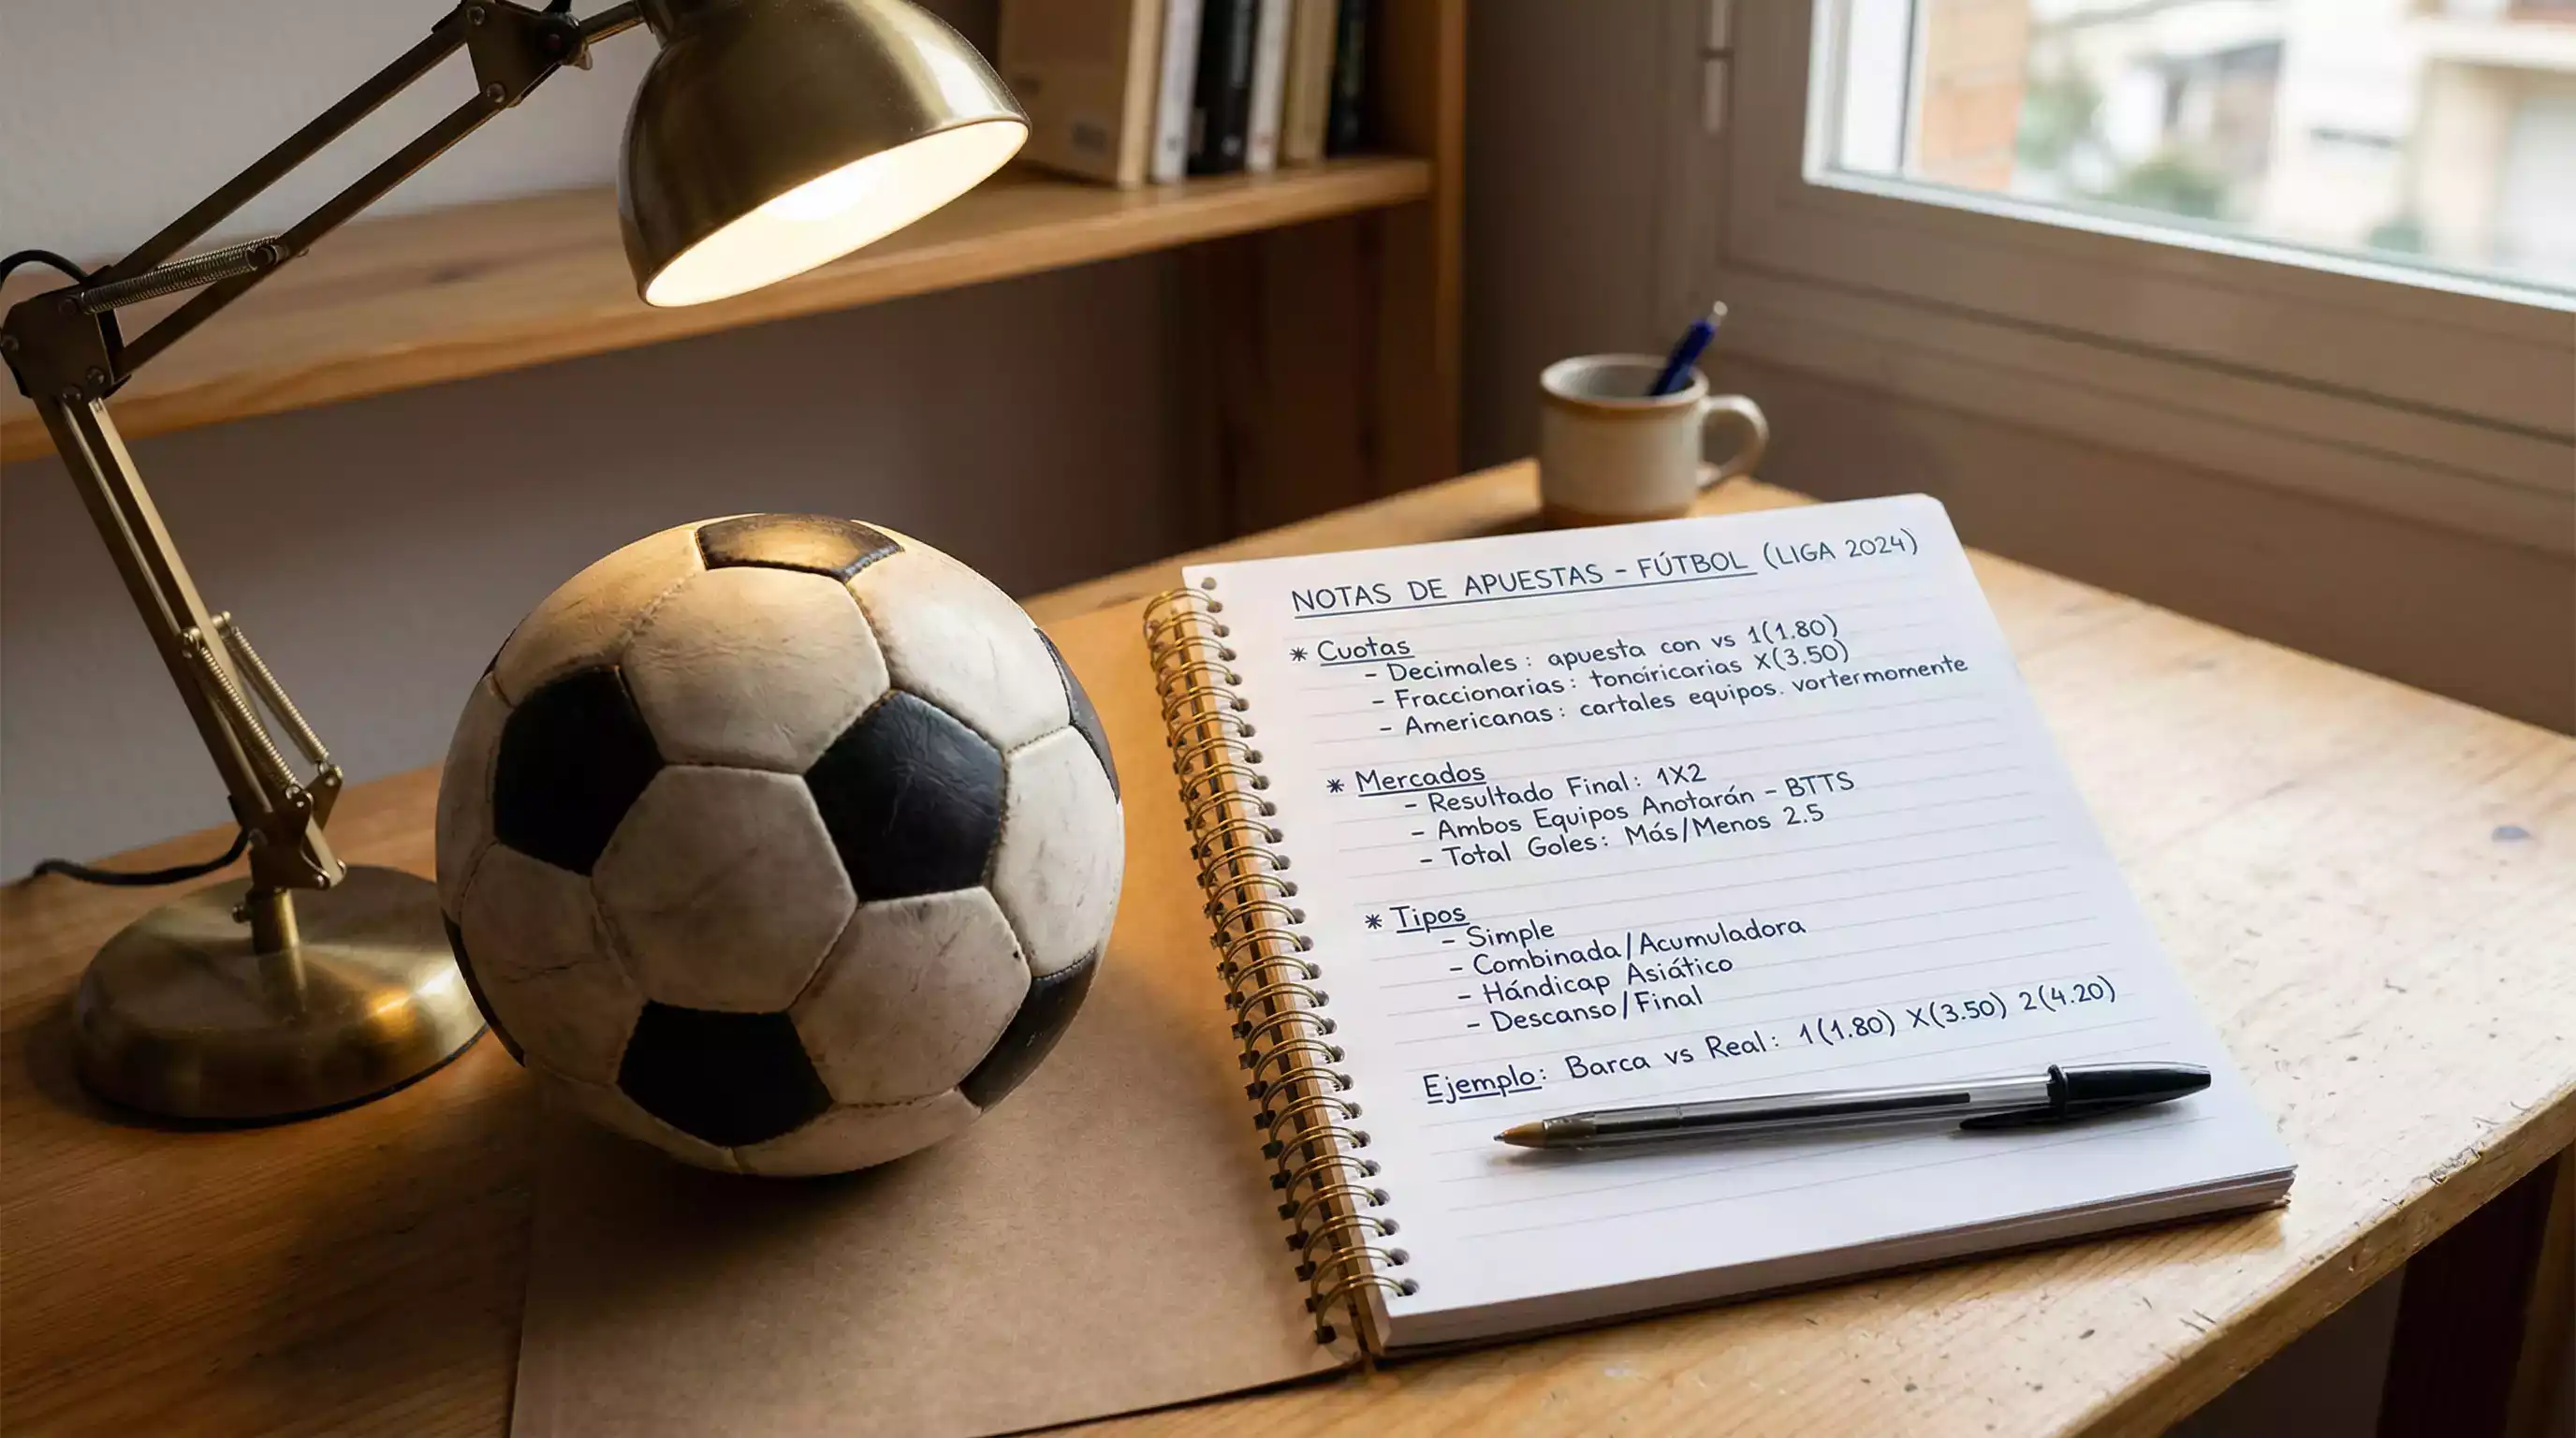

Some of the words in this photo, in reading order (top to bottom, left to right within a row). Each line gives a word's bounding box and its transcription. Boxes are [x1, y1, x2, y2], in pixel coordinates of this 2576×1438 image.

[1292, 582, 1392, 612] NOTAS
[1408, 579, 1447, 601] DE
[1465, 563, 1603, 596] APUESTAS
[1637, 550, 1749, 580] FÚTBOL
[1764, 541, 1837, 570] (LIGA
[1845, 527, 1919, 556] 2024)
[1317, 637, 1411, 663] Cuotas
[1548, 638, 1647, 671] apuesta
[1661, 638, 1701, 654] con
[1711, 634, 1736, 649] vs
[1748, 613, 1837, 645] 1(1.80)
[1753, 638, 1850, 671] X(3.50)
[1579, 691, 1676, 717] cartales
[1354, 761, 1486, 796] Mercados
[1427, 781, 1554, 813] Resultado
[1656, 763, 1707, 786] 1X2
[1438, 816, 1523, 841] Ambos
[1532, 804, 1630, 833] Equipos
[1643, 785, 1755, 816] Anotarán
[1784, 770, 1855, 798] BTTS
[1442, 841, 1512, 867] Total
[1782, 802, 1825, 826] 2.5
[1389, 905, 1471, 934] Tipos
[1466, 918, 1556, 948] Simple
[1483, 974, 1611, 1005] Hándicap
[1628, 956, 1734, 986] Asiático
[1564, 1054, 1650, 1079] Barca
[1663, 1048, 1694, 1064] vs
[1799, 1008, 1895, 1046] 1(1.80)
[1906, 991, 2008, 1029] X(3.50)
[2018, 975, 2116, 1013] 2(4.20)
